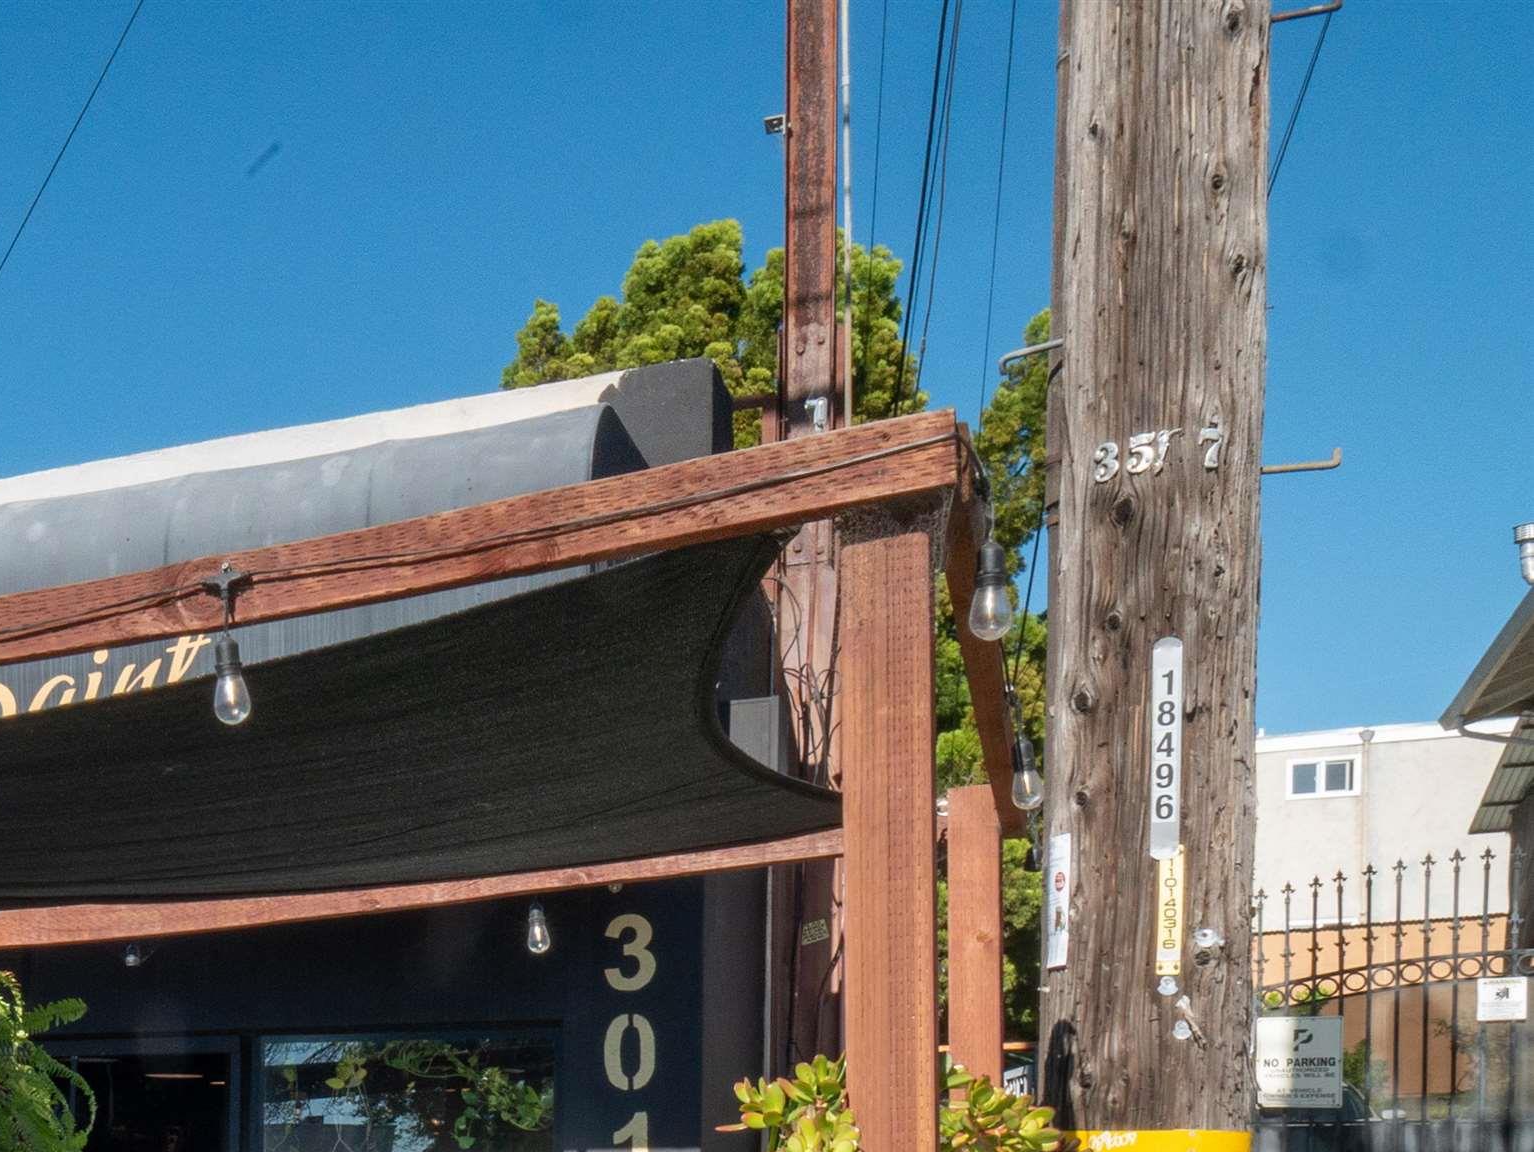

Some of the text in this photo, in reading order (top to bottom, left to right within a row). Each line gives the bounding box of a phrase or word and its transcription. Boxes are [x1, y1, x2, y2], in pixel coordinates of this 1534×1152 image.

[1155, 670, 1175, 821] 18496
[1264, 1057, 1336, 1068] NO PARKING
